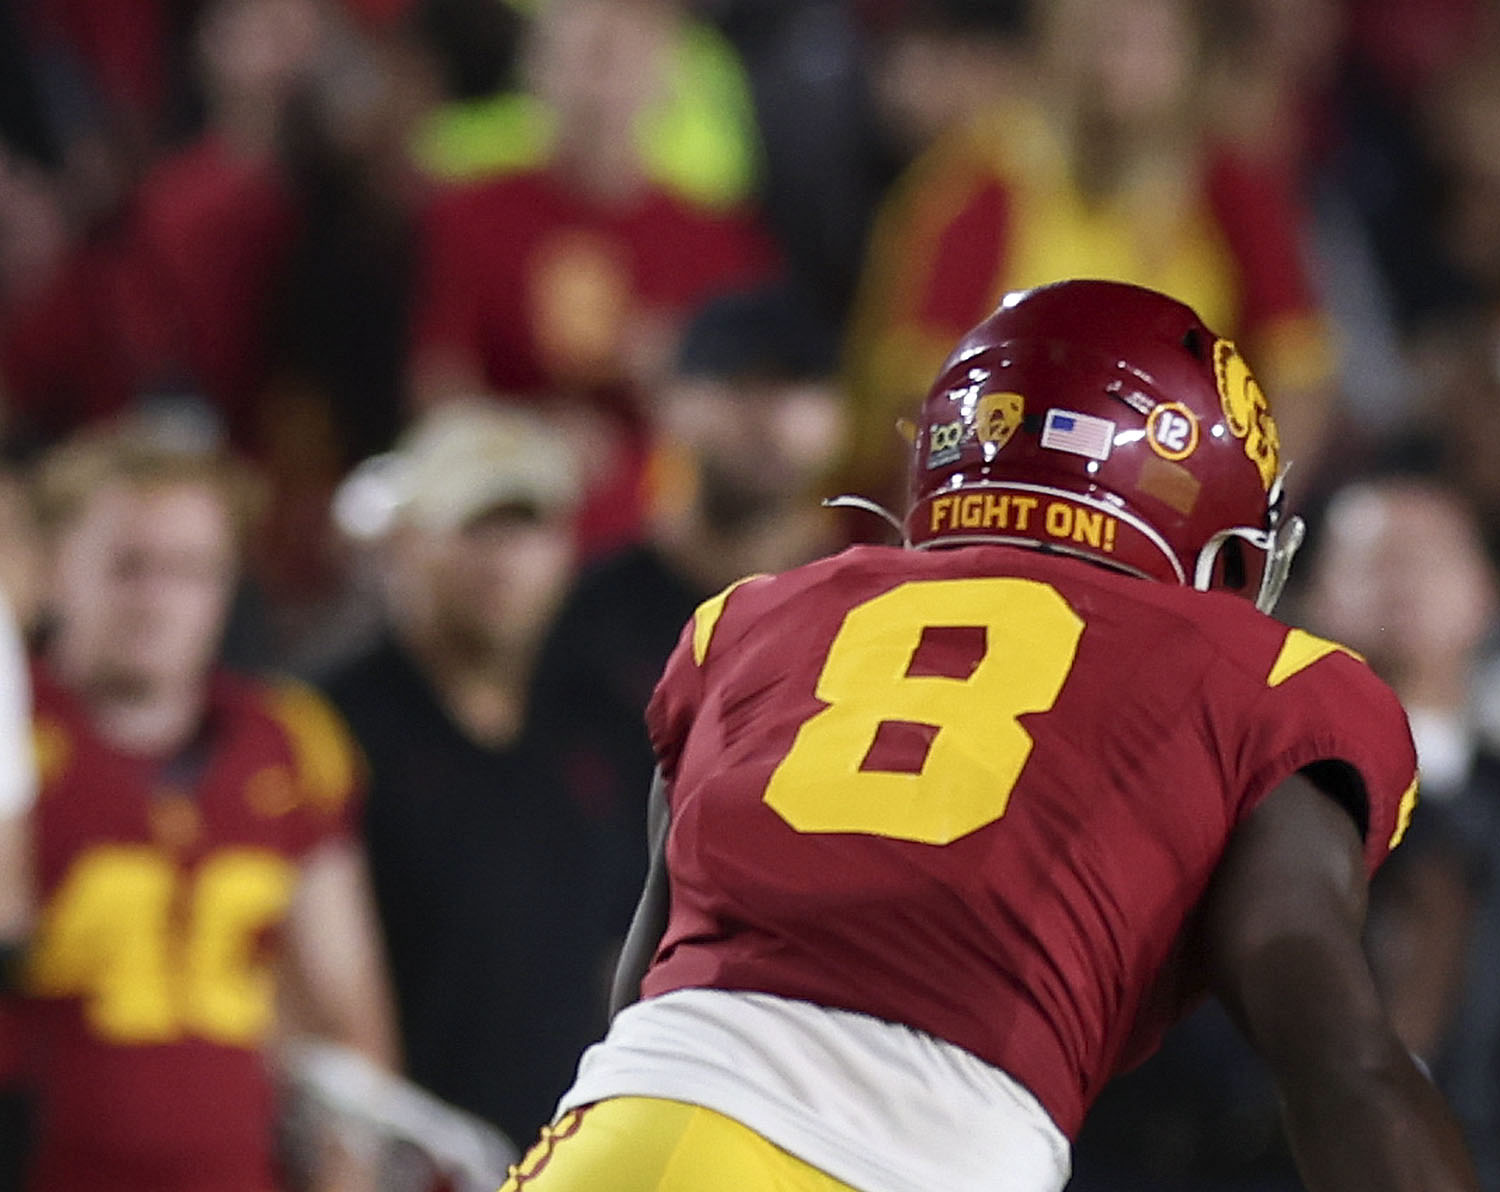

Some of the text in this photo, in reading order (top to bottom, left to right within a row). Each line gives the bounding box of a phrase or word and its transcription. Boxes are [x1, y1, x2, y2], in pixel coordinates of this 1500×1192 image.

[1157, 411, 1189, 452] 12
[930, 493, 1117, 553] FIGHT ON!
[762, 576, 1086, 846] 8
